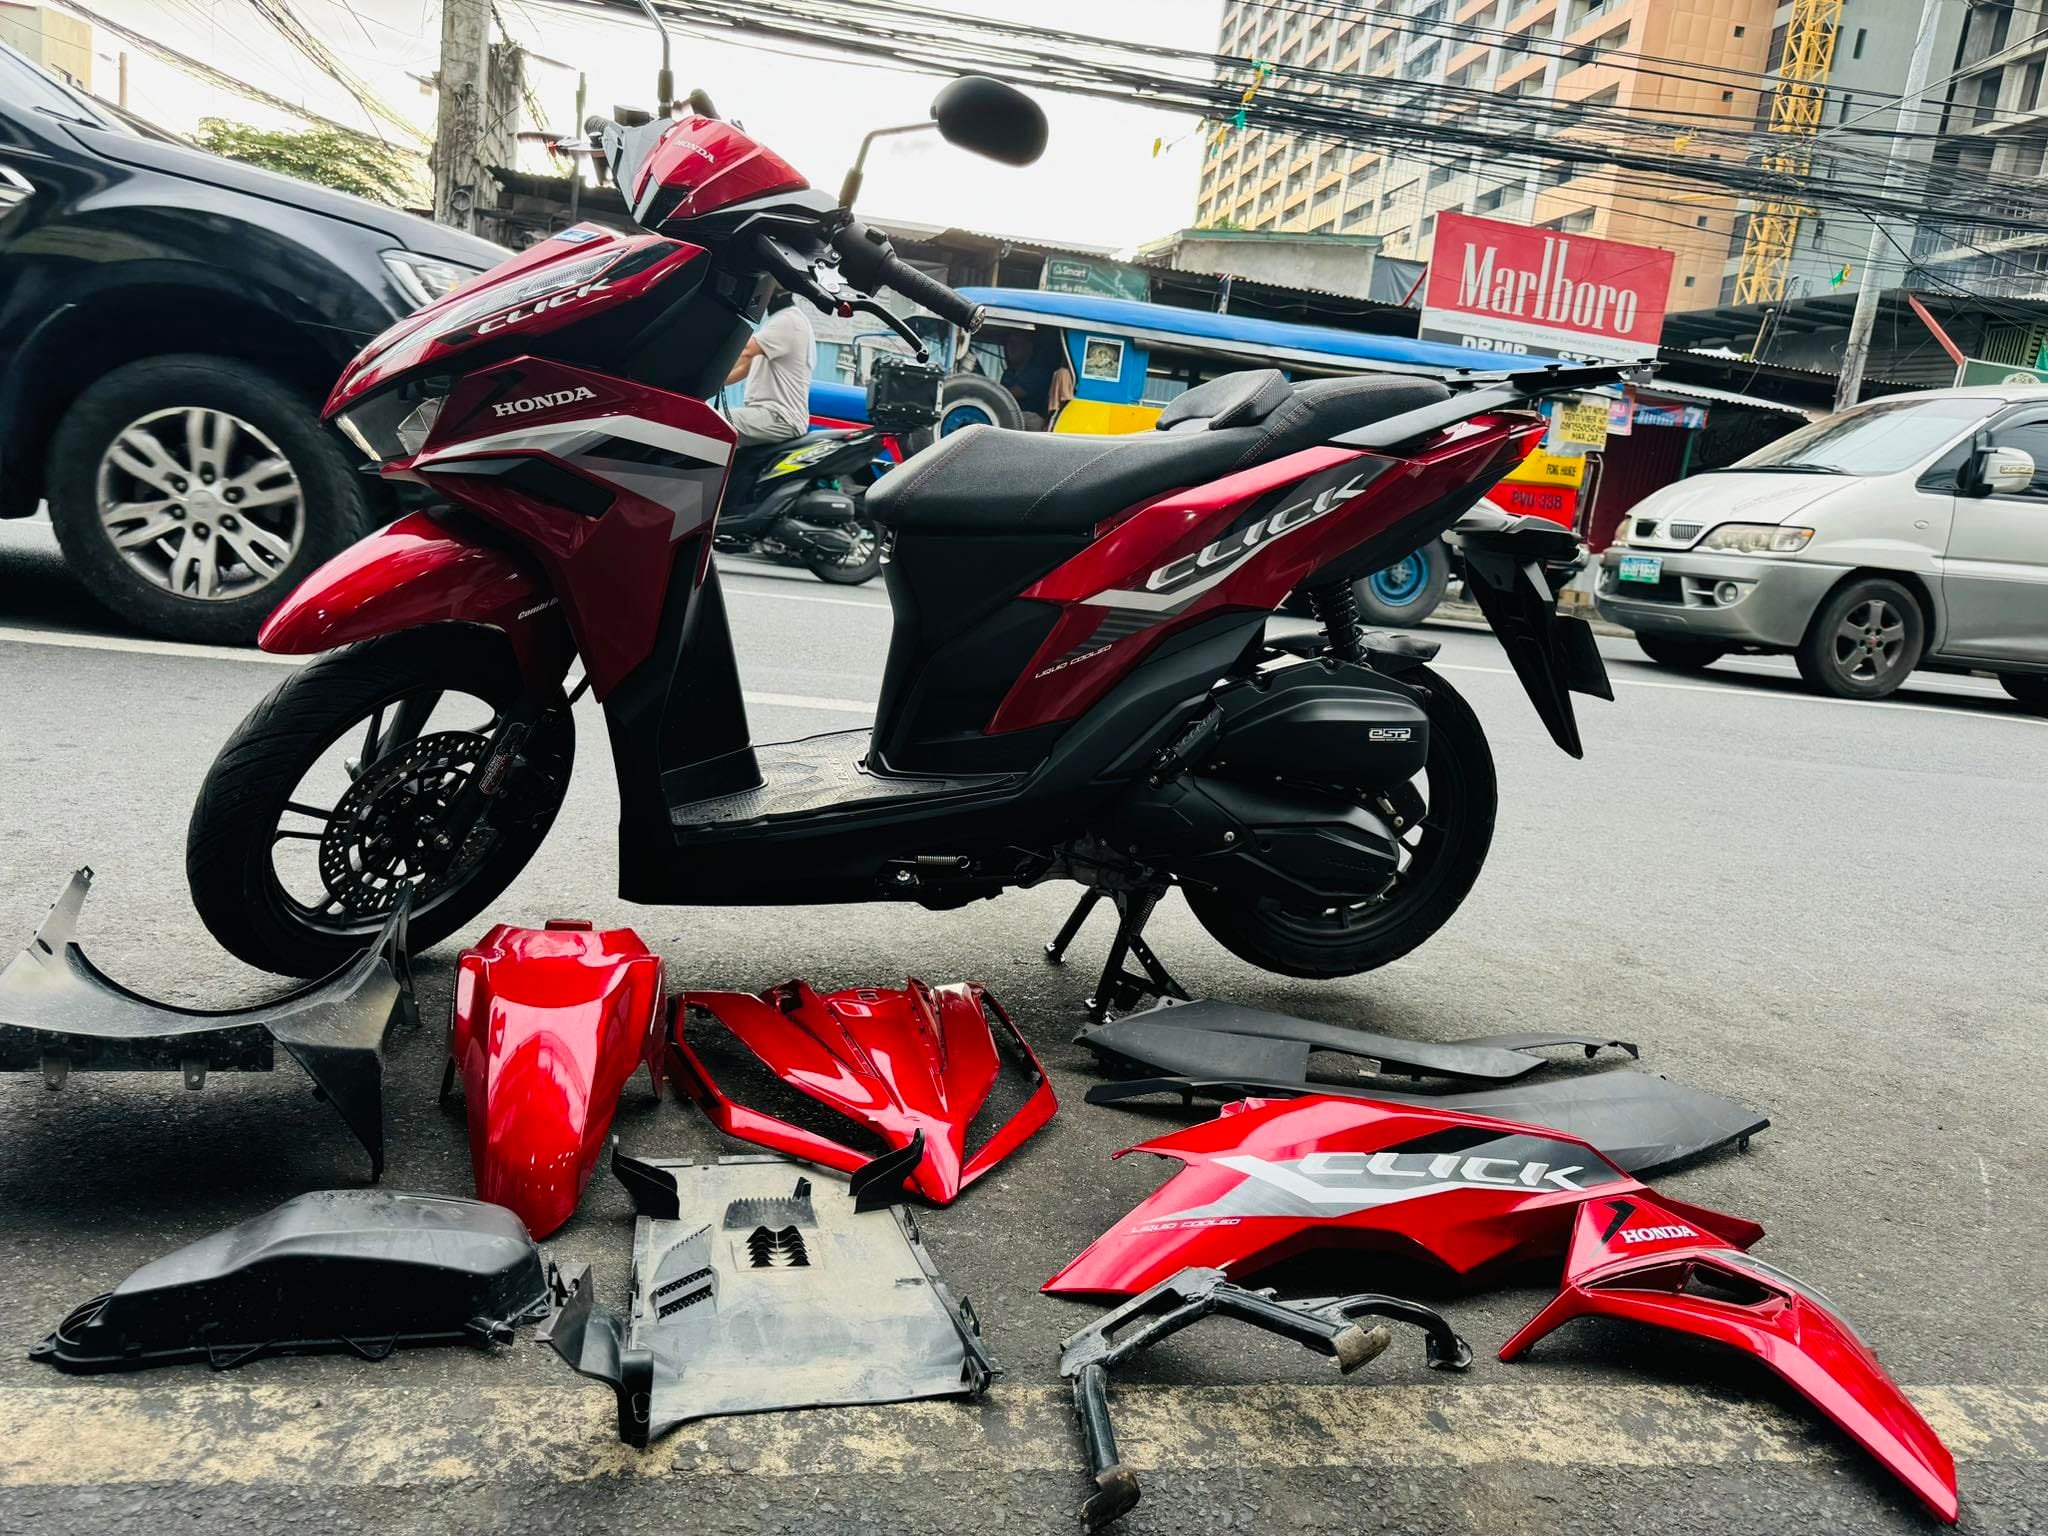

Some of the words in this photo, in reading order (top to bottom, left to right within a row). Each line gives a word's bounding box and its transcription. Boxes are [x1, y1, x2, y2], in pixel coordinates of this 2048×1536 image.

[673, 139, 715, 164] HONDA
[1061, 265, 1087, 279] Smart
[1457, 236, 1638, 334] Marlboro
[477, 278, 614, 335] CLICK
[492, 386, 598, 417] HONDA
[1146, 473, 1366, 591] CLICK
[1034, 661, 1068, 679] LIQUID
[1070, 643, 1113, 665] COOLED
[1297, 1152, 1586, 1192] CLICK
[1131, 1222, 1178, 1233] LIQUID
[1181, 1218, 1241, 1229] COOLED
[1619, 1225, 1700, 1244] HONDA
